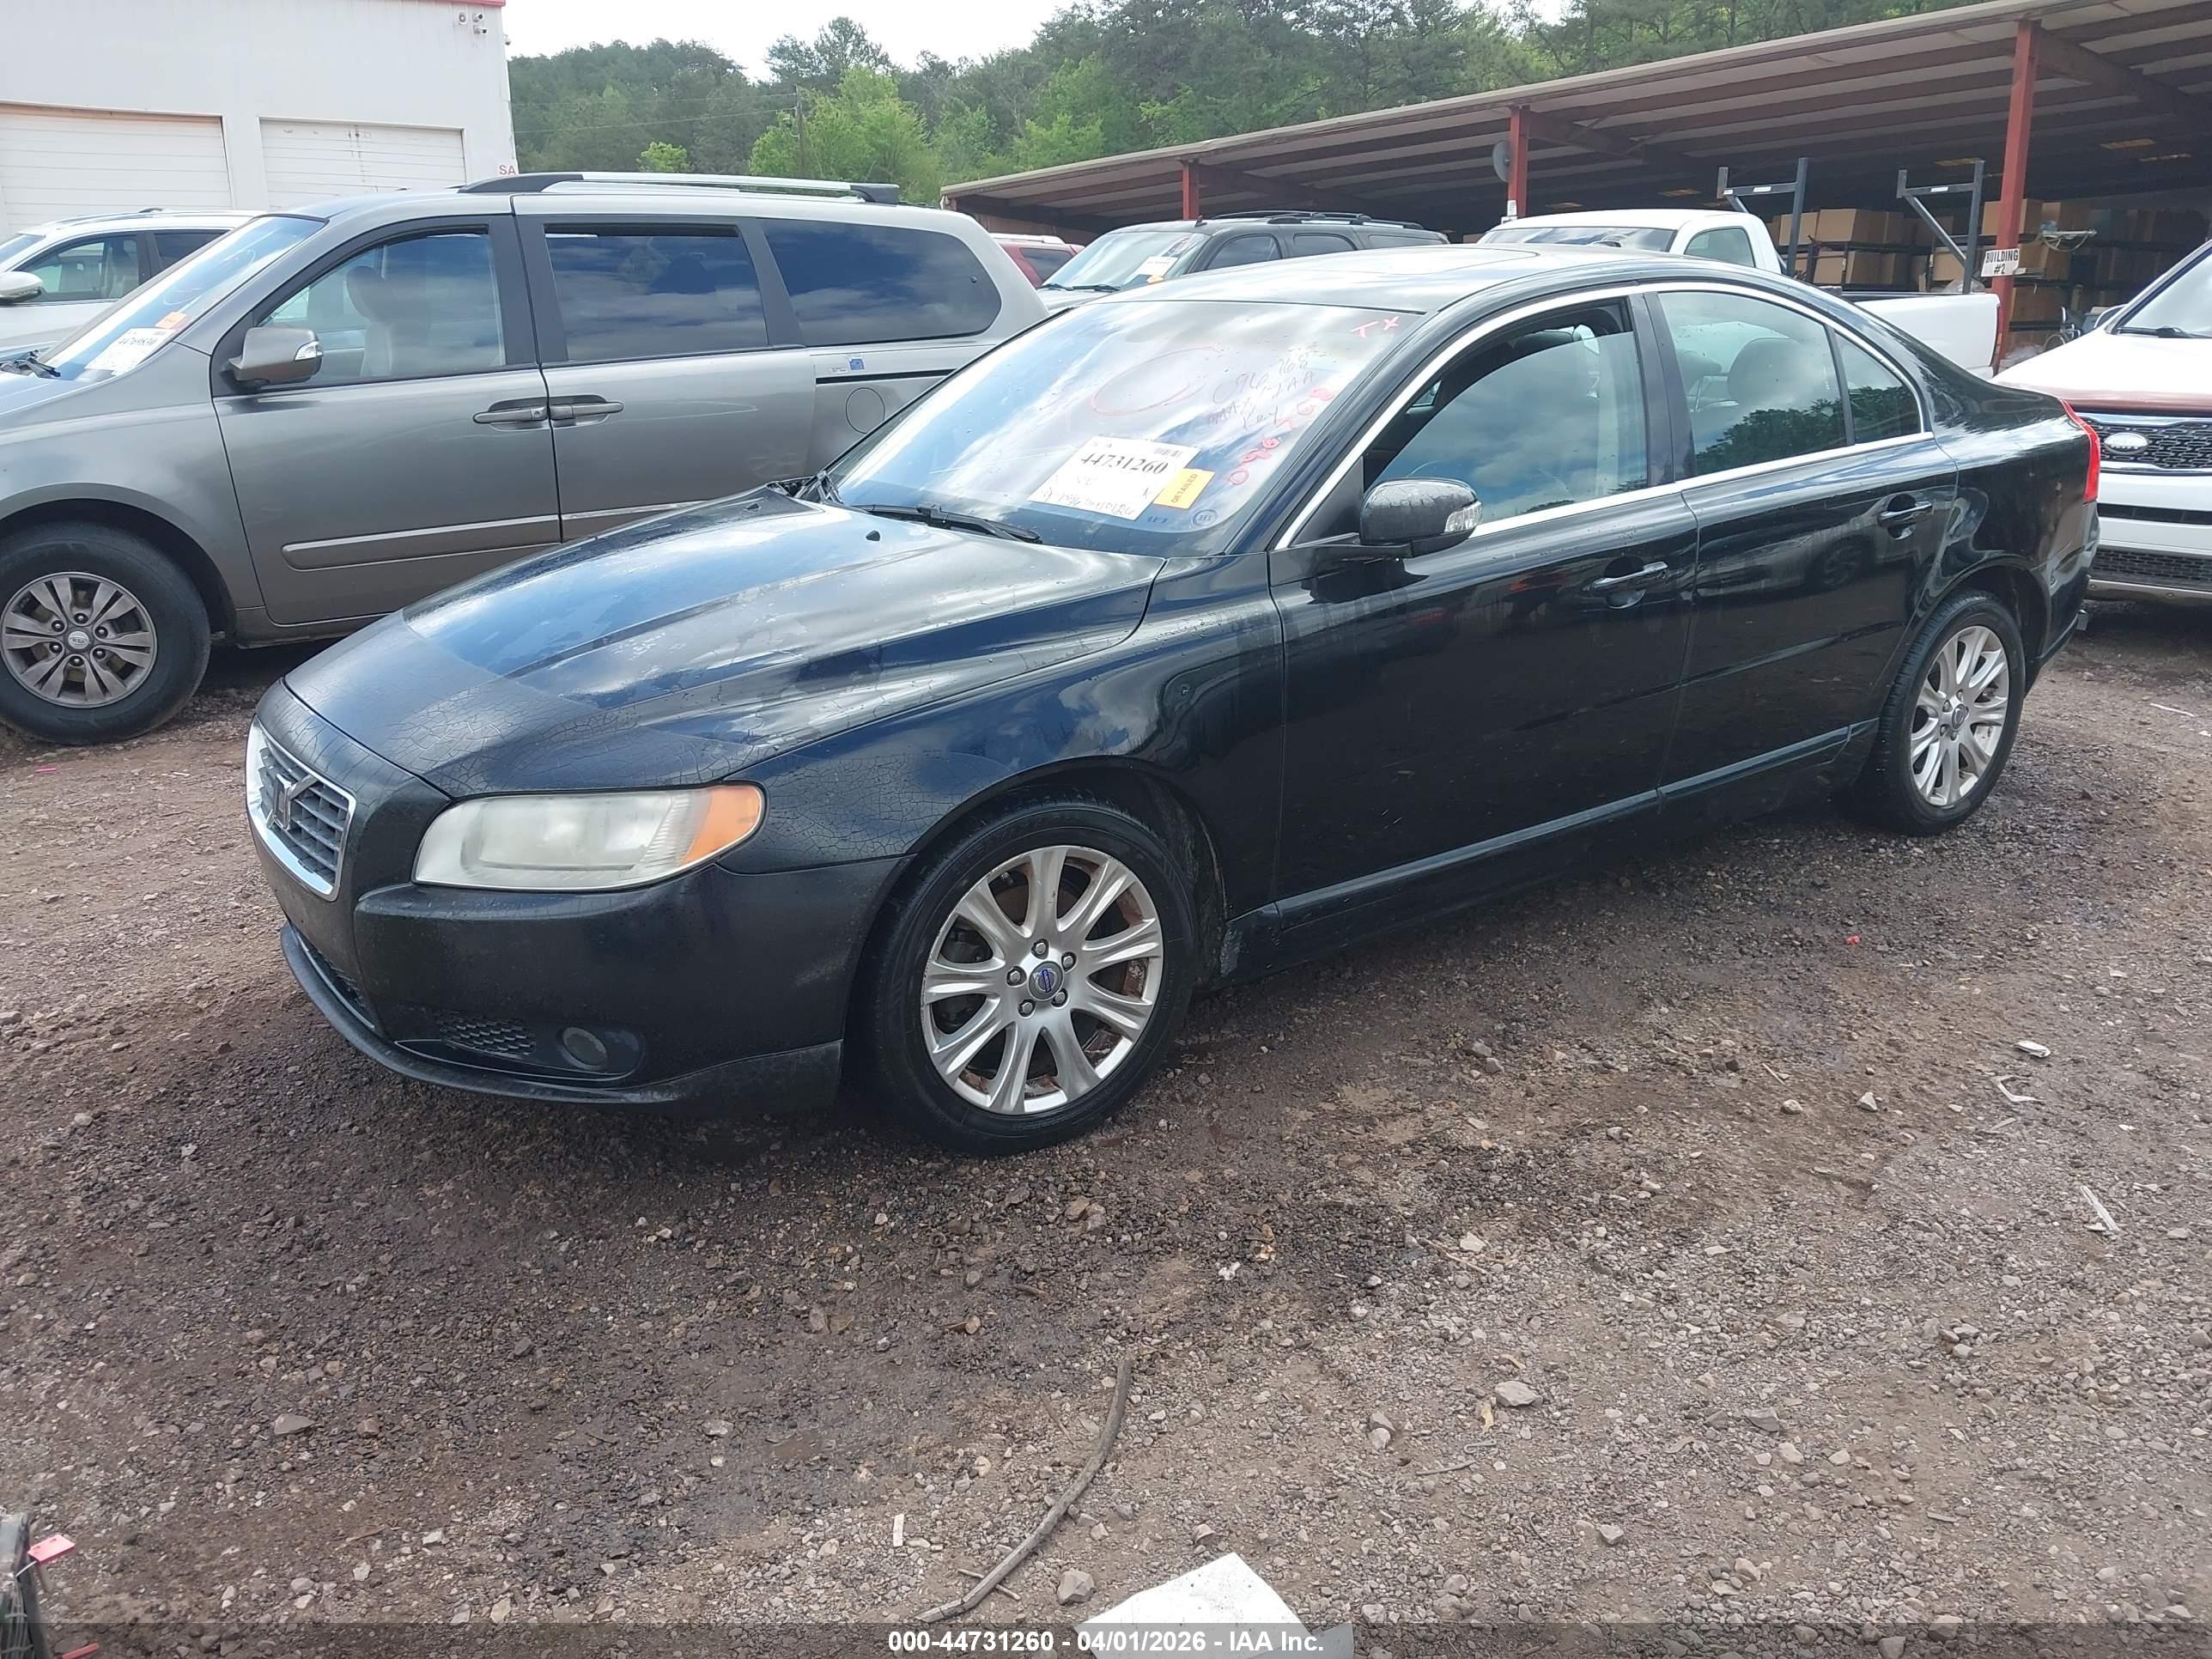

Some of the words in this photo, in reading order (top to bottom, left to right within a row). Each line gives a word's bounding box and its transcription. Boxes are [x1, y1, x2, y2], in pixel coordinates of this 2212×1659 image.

[499, 164, 516, 175] SA
[1985, 249, 2019, 263] BUILDING
[1994, 263, 2006, 275] #2
[1080, 453, 1169, 474] 44731260
[1170, 473, 1198, 503] DETAILED
